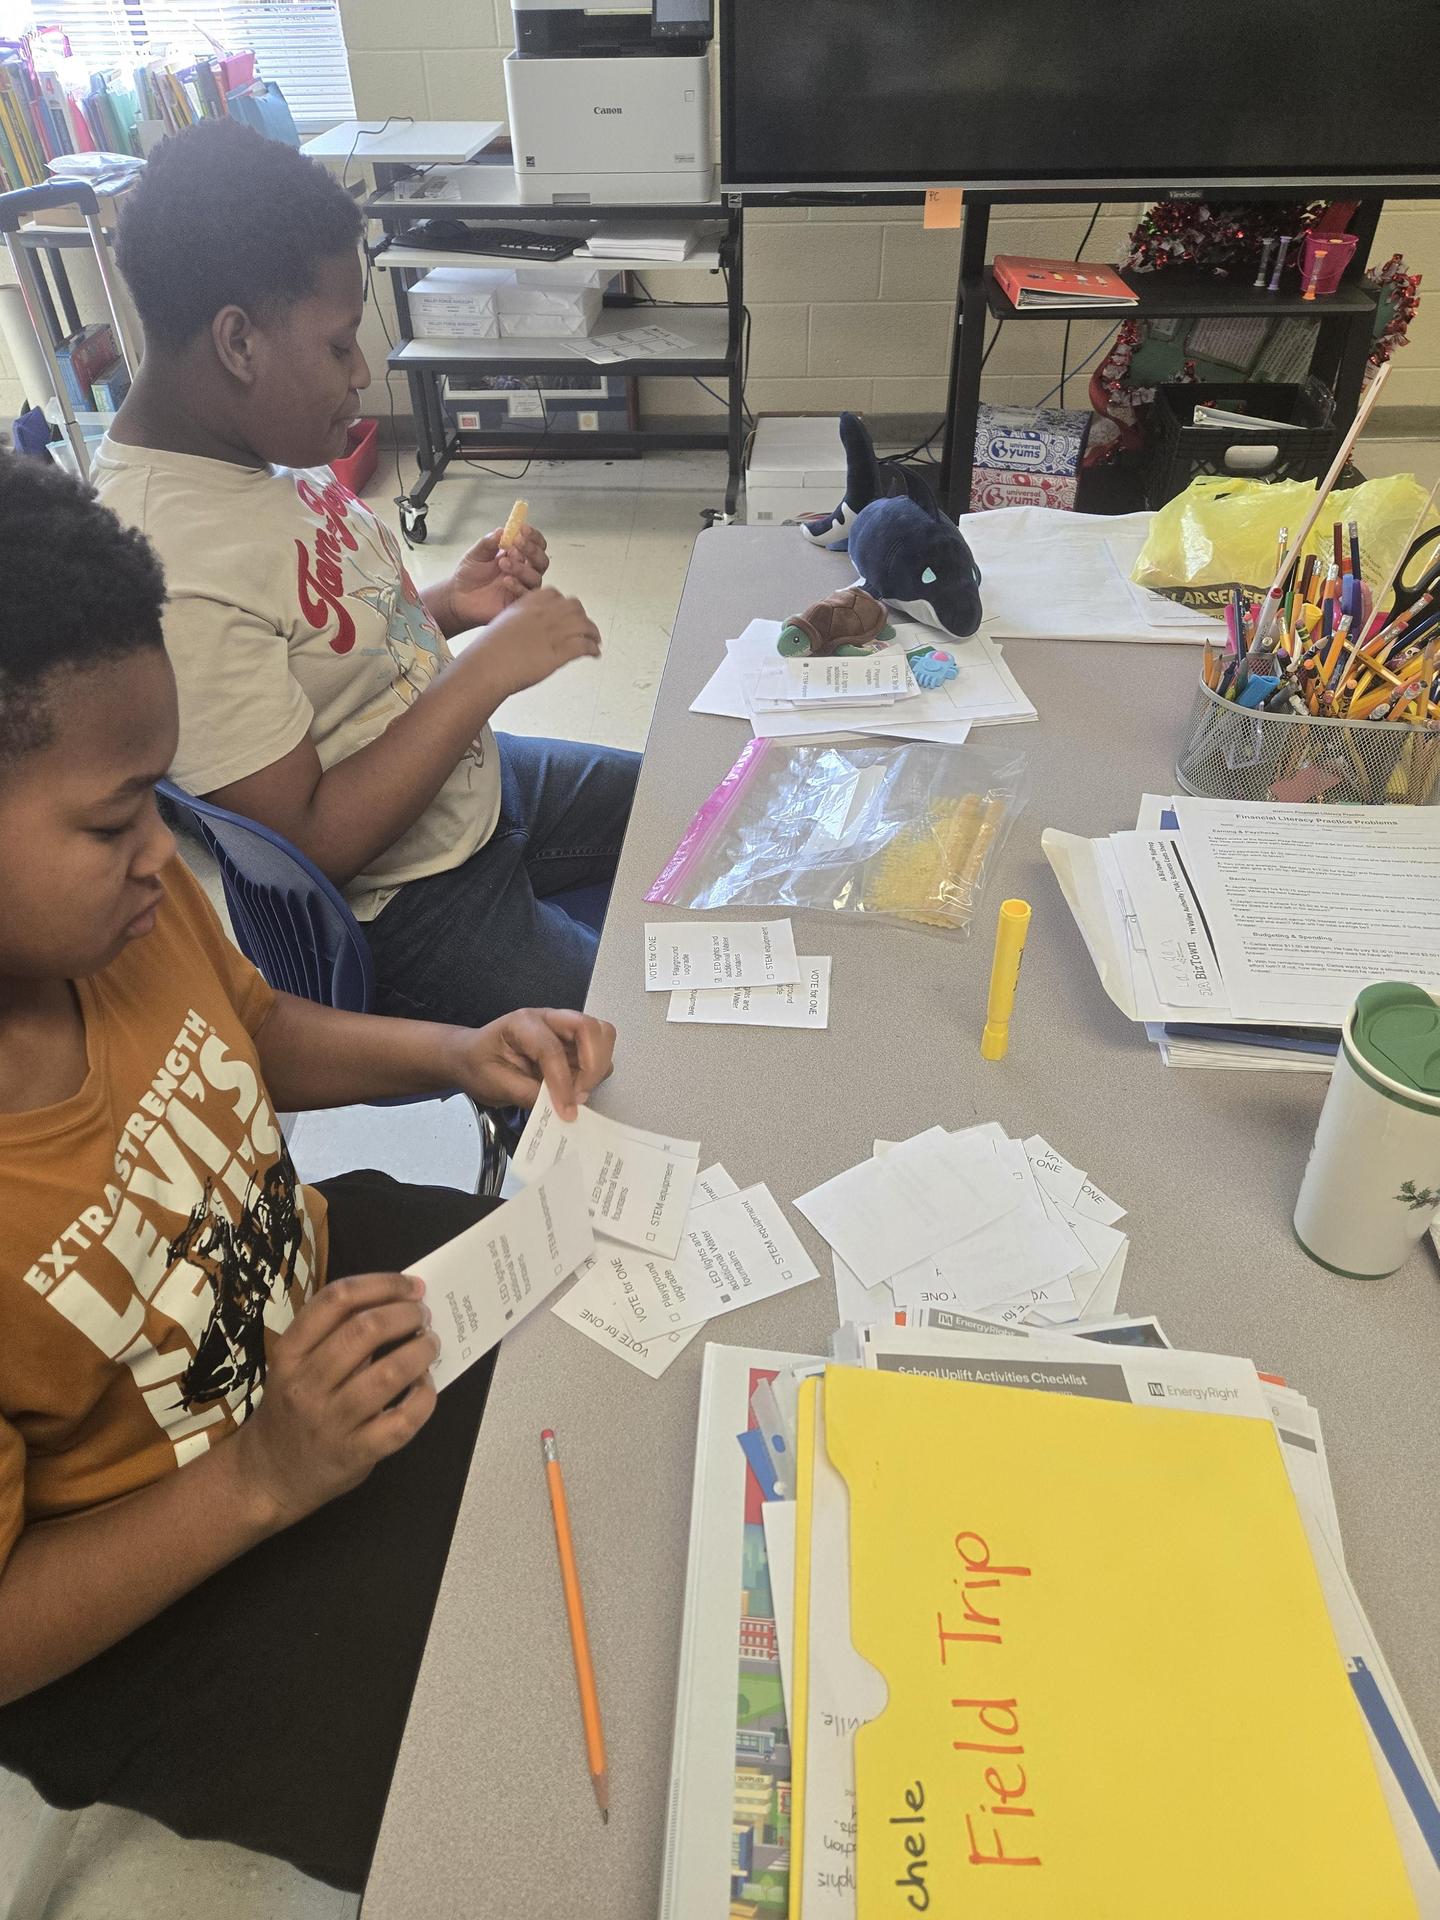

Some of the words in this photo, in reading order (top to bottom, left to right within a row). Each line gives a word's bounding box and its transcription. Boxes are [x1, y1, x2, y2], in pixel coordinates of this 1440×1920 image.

[593, 106, 623, 115] Canon
[929, 191, 941, 202] PC
[1009, 442, 1041, 450] universal
[1009, 448, 1041, 459] yums
[1005, 496, 1041, 506] yums
[1006, 489, 1041, 498] universal
[1278, 815, 1314, 823] Literacy
[648, 935, 657, 951] ONE
[711, 935, 719, 948] and
[721, 936, 731, 954] Water
[761, 926, 774, 956] equipment
[1252, 931, 1290, 939] Budgeting
[1298, 934, 1333, 942] Spending
[671, 945, 680, 977] Playground
[683, 953, 691, 976] upgrade
[712, 948, 721, 963] lights
[723, 953, 733, 978] additional
[734, 953, 743, 978] fountains
[765, 956, 774, 970] STEM
[1187, 941, 1208, 980] BizTown
[649, 962, 658, 981] VOTE
[713, 962, 722, 975] LED
[811, 969, 820, 989] VOTE
[742, 999, 750, 1011] and
[809, 988, 818, 1001] for
[808, 999, 818, 1016] ONE
[22, 1183, 123, 1298] EXTRA
[113, 1008, 209, 1174] STRENGTH
[1035, 1158, 1063, 1175] ONE
[45, 1033, 259, 1360] LEVI'S
[601, 1181, 618, 1217] additional
[650, 1202, 665, 1227] STEM
[659, 1162, 675, 1202] equipment
[1081, 1184, 1107, 1205] ONE
[741, 1199, 769, 1239] equipment
[688, 1231, 703, 1248] and
[701, 1229, 718, 1256] Water
[697, 1245, 713, 1273] lights
[764, 1237, 784, 1265] STEM
[610, 1257, 628, 1281] ONE
[708, 1269, 724, 1289] LED
[715, 1251, 740, 1292] additional
[727, 1249, 752, 1288] fountains
[500, 1283, 511, 1305] LED
[621, 1277, 634, 1296] for
[645, 1262, 671, 1308] Playground
[664, 1268, 686, 1303] upgrade
[920, 1292, 948, 1302] ONE
[445, 1291, 467, 1344] Playground
[462, 1295, 480, 1333] upgrade
[579, 1308, 604, 1329] ONE
[628, 1293, 648, 1324] VOTE
[604, 1323, 621, 1338] for
[955, 1315, 1016, 1337] EnergyRight
[617, 1334, 650, 1359] VOTE
[898, 1365, 940, 1380] School
[940, 1367, 973, 1382] Uplift
[975, 1369, 1030, 1384] Activities
[1031, 1371, 1089, 1386] Checklist
[1166, 1384, 1239, 1401] EnergyRight
[937, 1531, 1032, 1667] Trip
[737, 1775, 765, 1784] SUPPLIES
[951, 1698, 1042, 1867] Field
